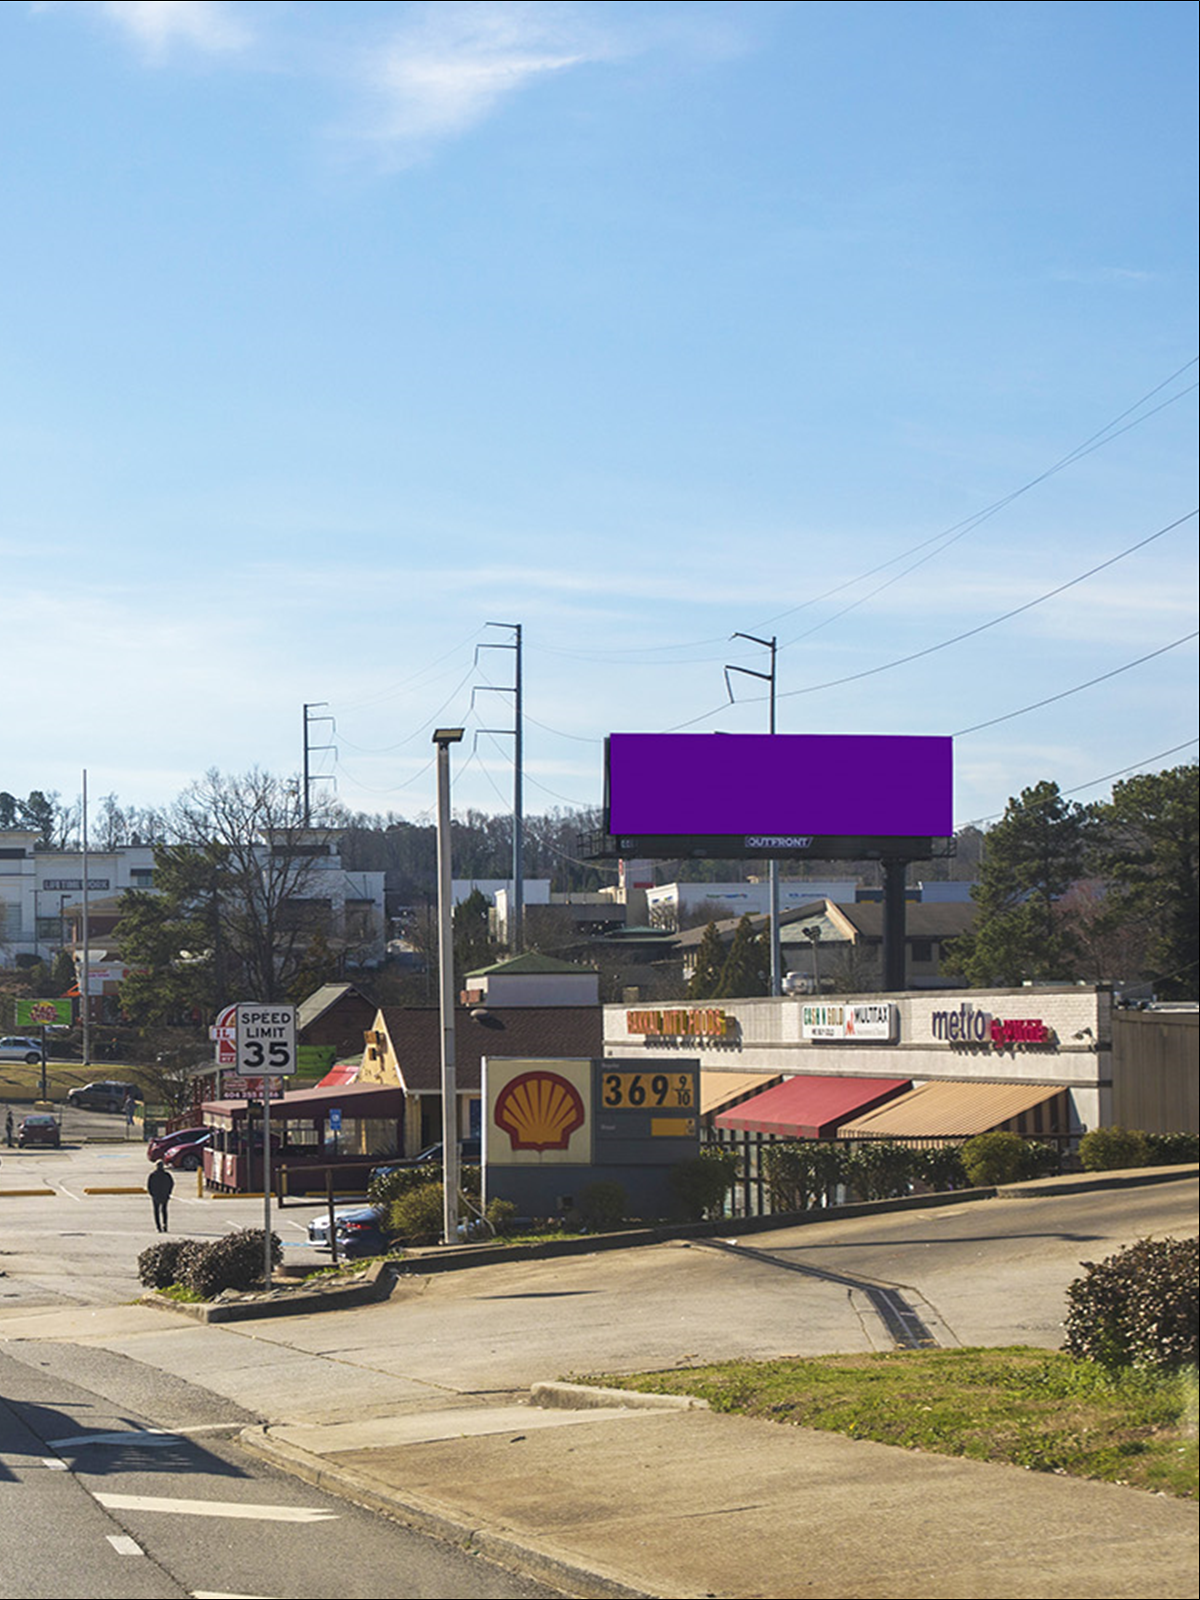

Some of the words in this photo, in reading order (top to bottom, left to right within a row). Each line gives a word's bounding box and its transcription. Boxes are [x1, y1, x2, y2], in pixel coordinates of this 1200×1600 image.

[749, 837, 808, 848] OUTFRONT
[241, 1012, 291, 1024] SPEED
[688, 1009, 726, 1035] FOODS
[804, 1007, 821, 1026] CASH
[828, 1007, 844, 1026] GOLD
[932, 1003, 986, 1041] metro
[246, 1027, 285, 1038] LIMIT
[243, 1041, 290, 1067] 35
[604, 1075, 668, 1106] 369
